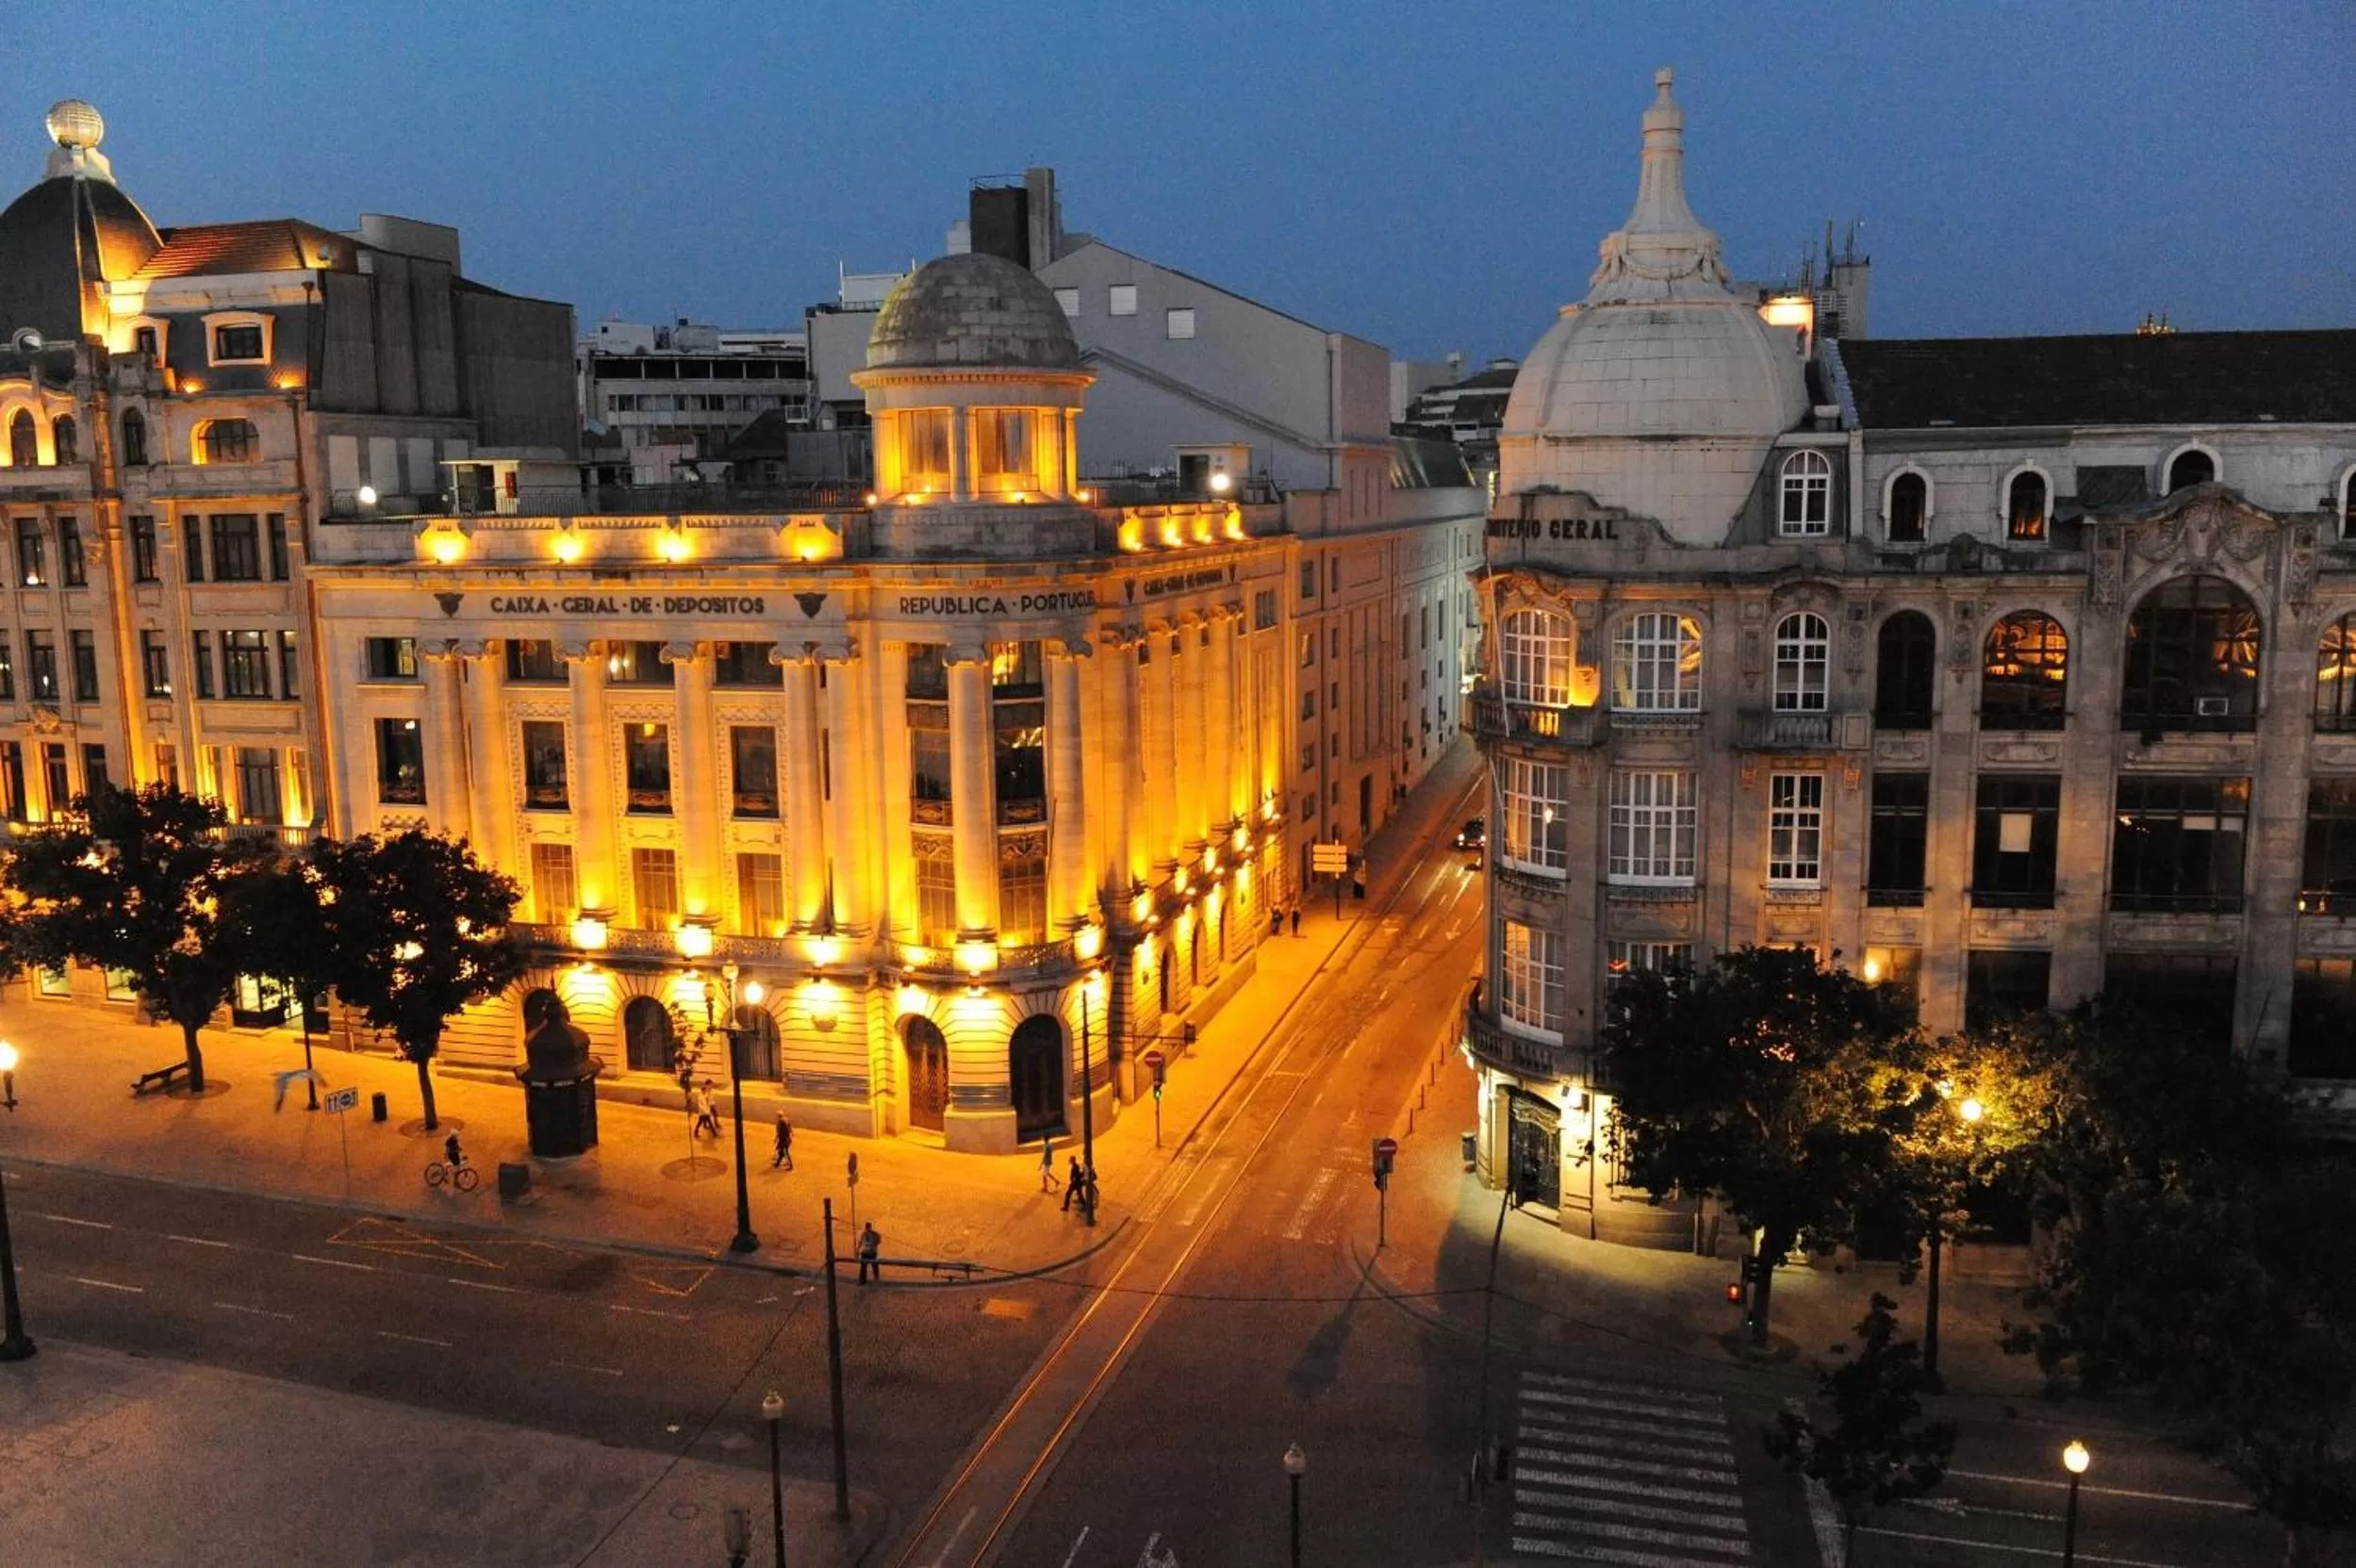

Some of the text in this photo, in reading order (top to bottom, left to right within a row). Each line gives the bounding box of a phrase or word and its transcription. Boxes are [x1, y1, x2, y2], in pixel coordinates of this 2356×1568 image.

[1549, 519, 1619, 540] GERAL
[490, 595, 765, 614] CAIXA GERAL DE DEPOSITOS
[899, 596, 1008, 615] REPUBLICA
